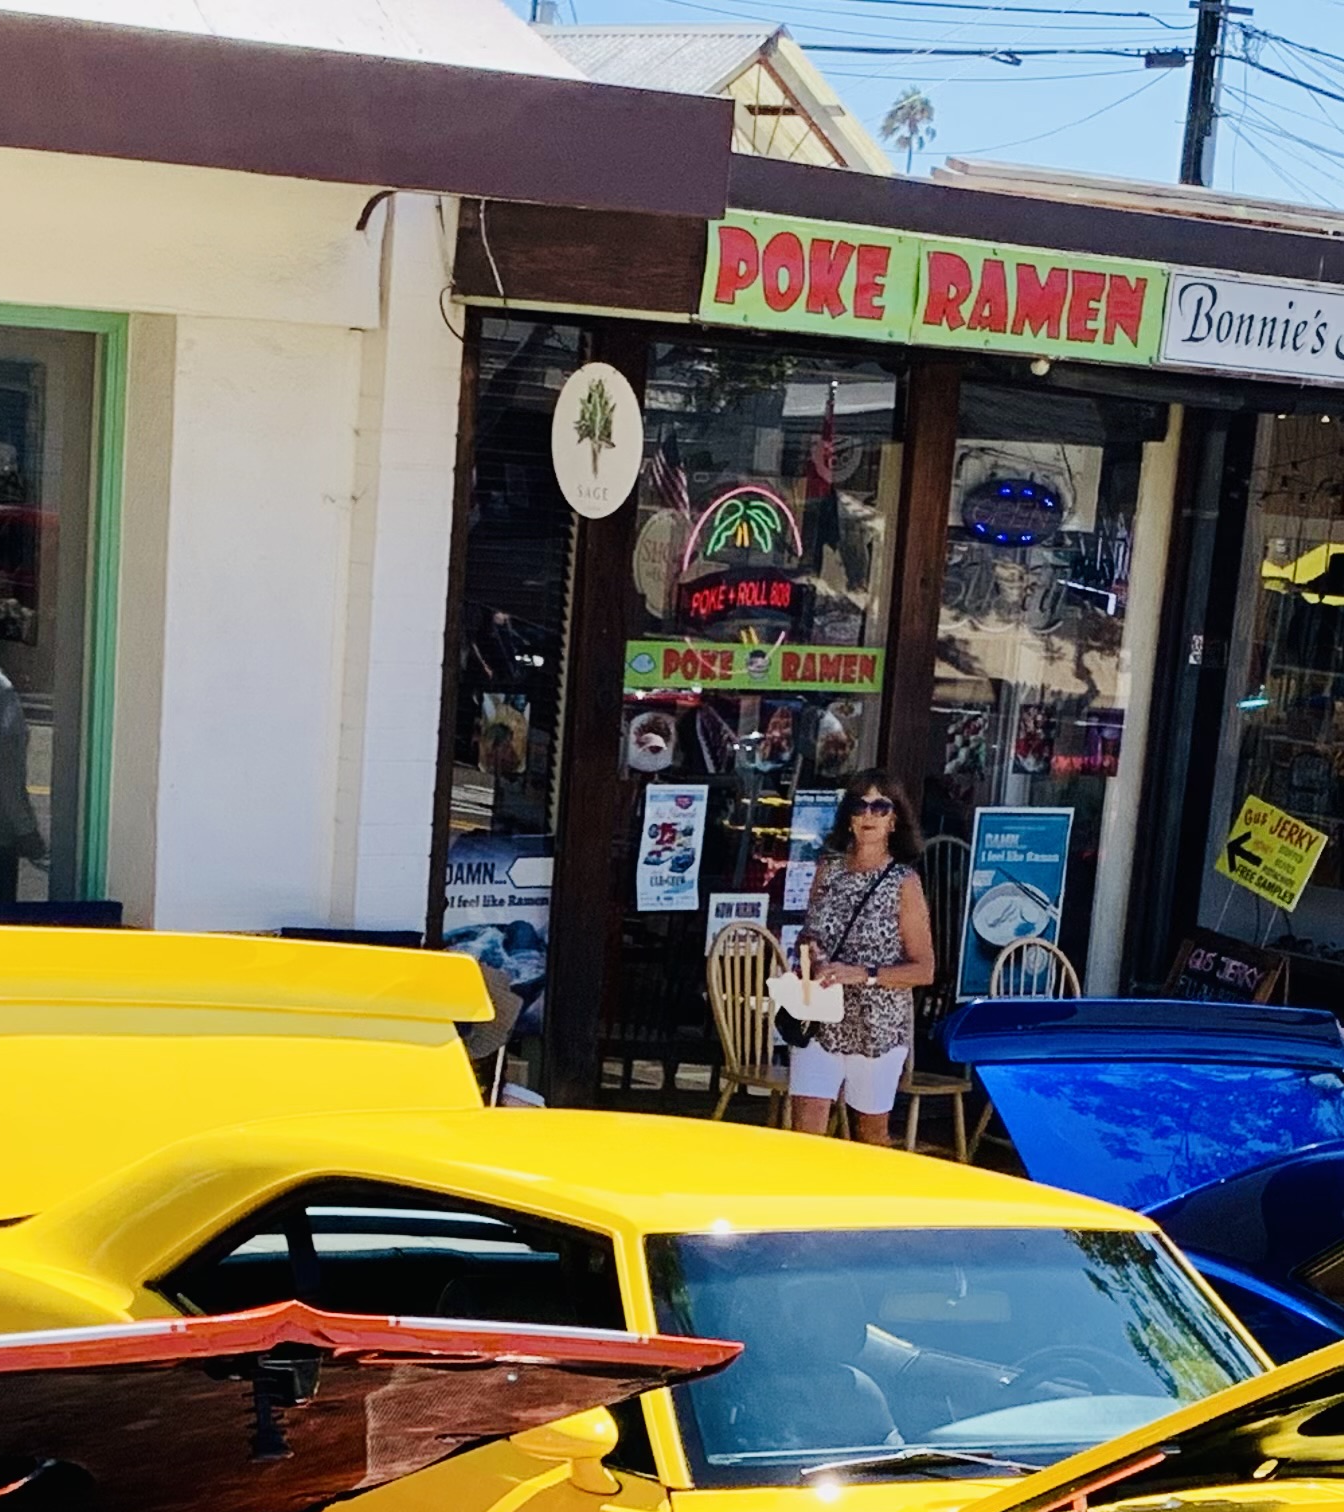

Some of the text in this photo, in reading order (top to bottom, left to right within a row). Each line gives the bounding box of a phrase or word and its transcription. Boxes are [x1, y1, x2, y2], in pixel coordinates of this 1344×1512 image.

[714, 226, 1148, 348] POKE RAMEN
[1178, 282, 1328, 355] Bonnie's
[577, 484, 609, 501] SAGE
[736, 580, 768, 607] ROLL
[662, 648, 877, 684] POKE RAMEN
[1268, 816, 1319, 854] JERKY
